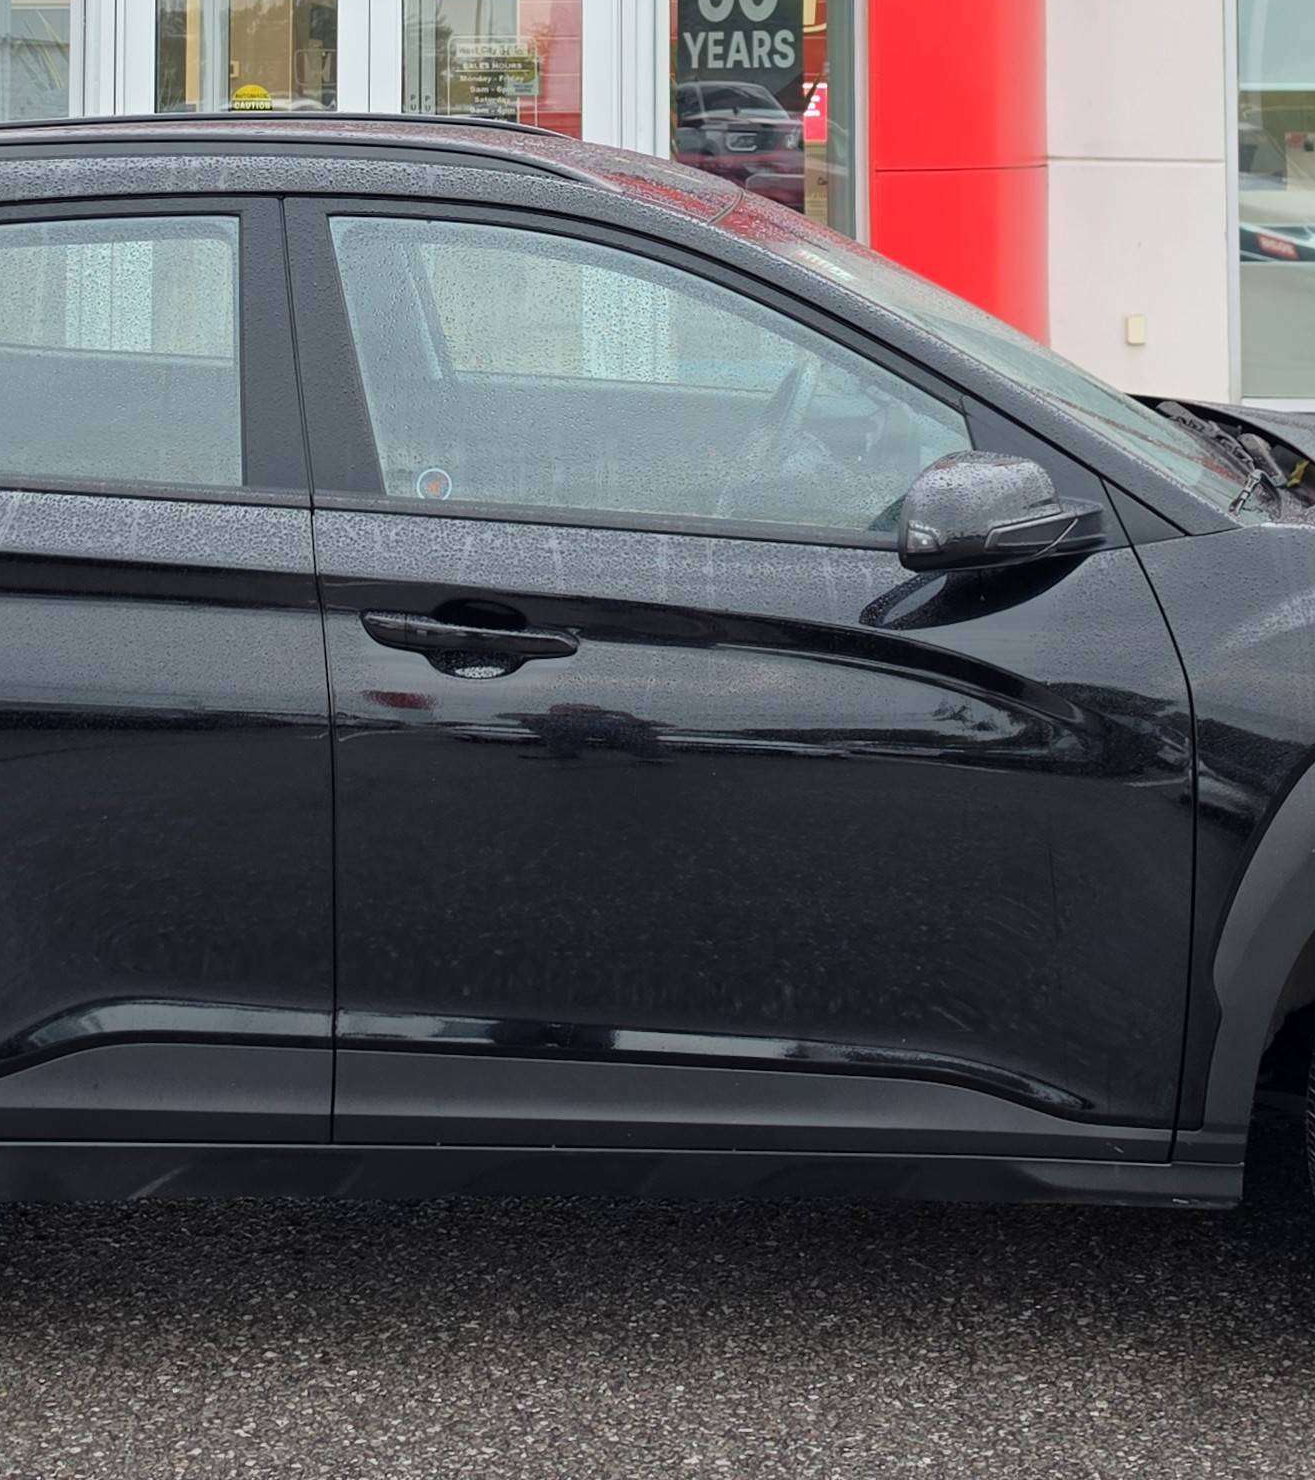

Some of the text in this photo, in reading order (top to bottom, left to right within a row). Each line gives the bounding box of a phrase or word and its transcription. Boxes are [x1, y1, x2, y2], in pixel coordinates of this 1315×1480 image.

[683, 28, 796, 69] YEARS
[462, 62, 523, 70] SALES HOURS
[234, 101, 271, 110] CAUTION
